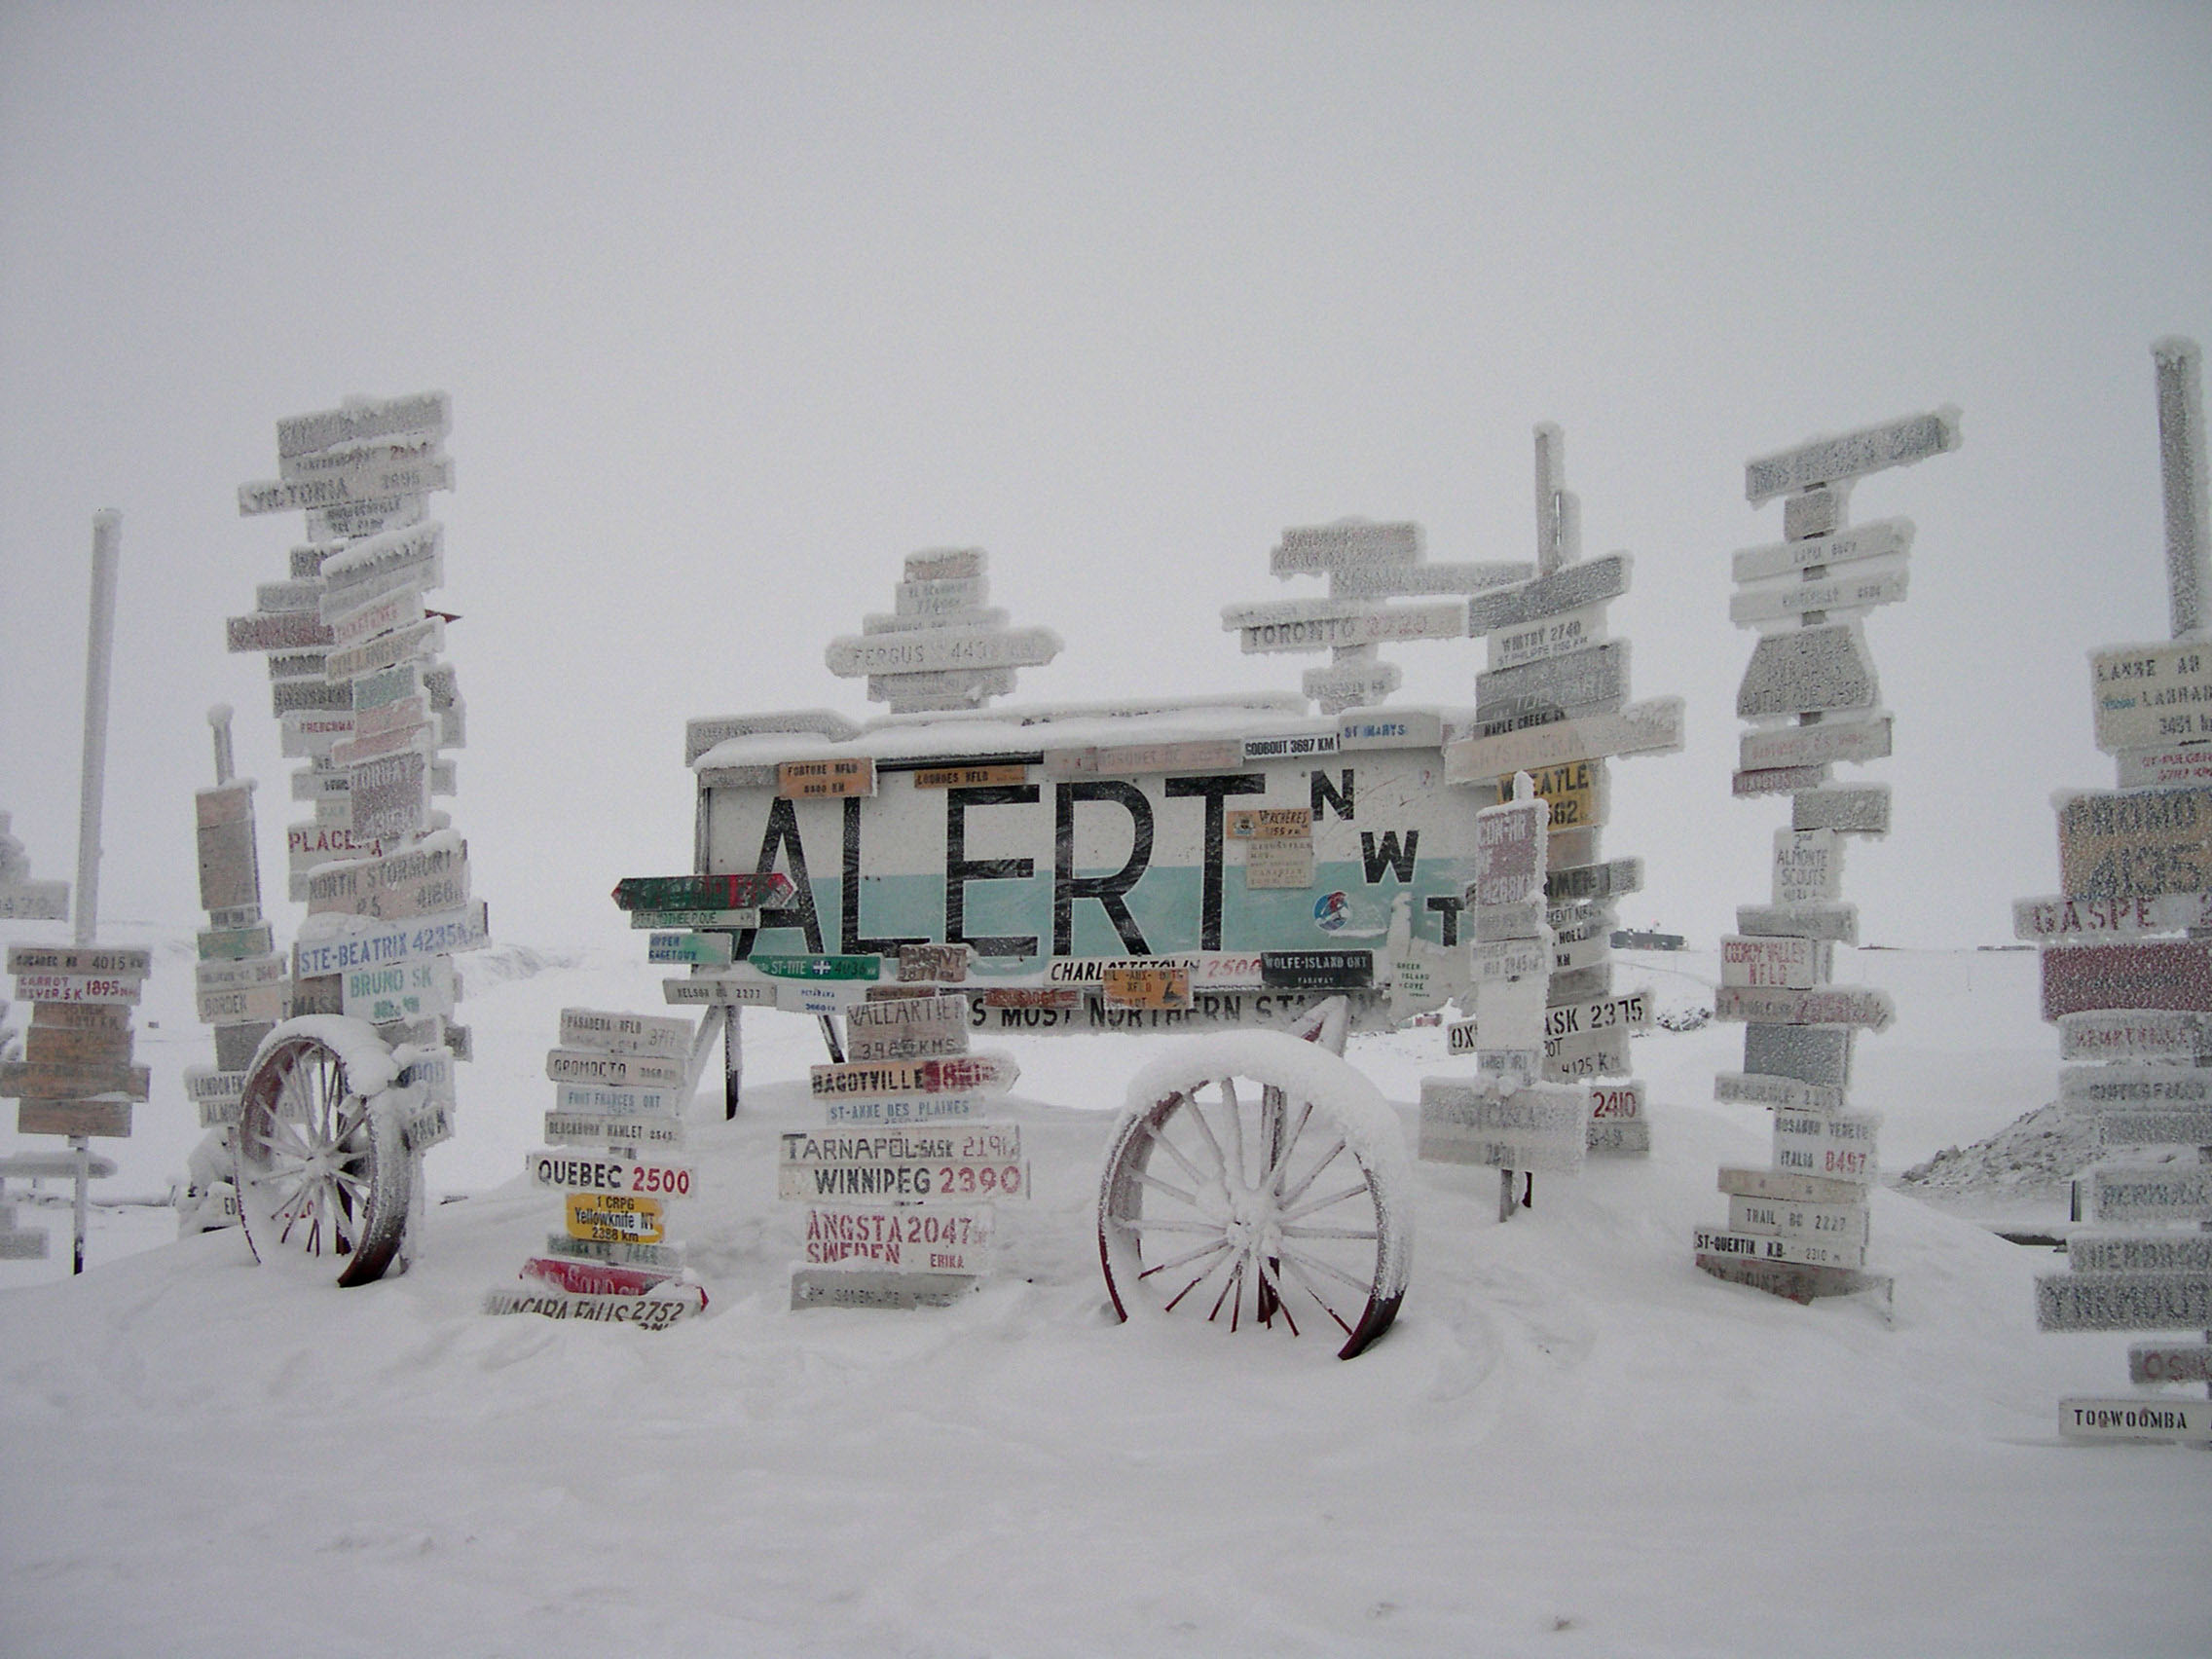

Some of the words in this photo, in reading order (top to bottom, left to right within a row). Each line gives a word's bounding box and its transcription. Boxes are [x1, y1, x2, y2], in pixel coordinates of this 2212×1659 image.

[1249, 619, 1355, 645] TORONTO
[854, 645, 924, 666] FERGUS
[1245, 741, 1287, 756] GODBOUT
[1317, 737, 1335, 751] KM
[736, 774, 1266, 961] ALERT
[1311, 769, 1355, 821] N
[1361, 830, 1419, 884] W
[1426, 896, 1465, 947] T
[300, 932, 408, 974] STE-BEATRIX
[1264, 955, 1345, 971] WOLFE-ISLAND
[350, 969, 404, 998] BRUNO
[1590, 997, 1643, 1029] 2375
[1562, 1057, 1594, 1076] 4125
[812, 1066, 924, 1094] BAGOTVILLE
[830, 1103, 881, 1121] ST-ANNE
[887, 1102, 909, 1118] DES
[918, 1099, 970, 1116] PLAINES
[1592, 1090, 1637, 1118] 2410
[608, 1124, 643, 1139] HAMLET
[1780, 1150, 1814, 1168] ITALIA
[538, 1159, 623, 1190] QUEBEC
[632, 1165, 690, 1195] 2500
[814, 1166, 932, 1195] WINNIPEG
[940, 1165, 1022, 1195] 2390
[606, 1196, 635, 1211] CRPG
[574, 1207, 635, 1230] Yellowknife
[641, 1212, 655, 1231] NT
[906, 1216, 974, 1244] 2047
[621, 1228, 640, 1242] km
[1696, 1234, 1756, 1255] ST-QUENTIN
[930, 1253, 965, 1270] ERIKA
[631, 1300, 685, 1322] 2752
[2073, 1407, 2188, 1430] TOOWOOMBA
